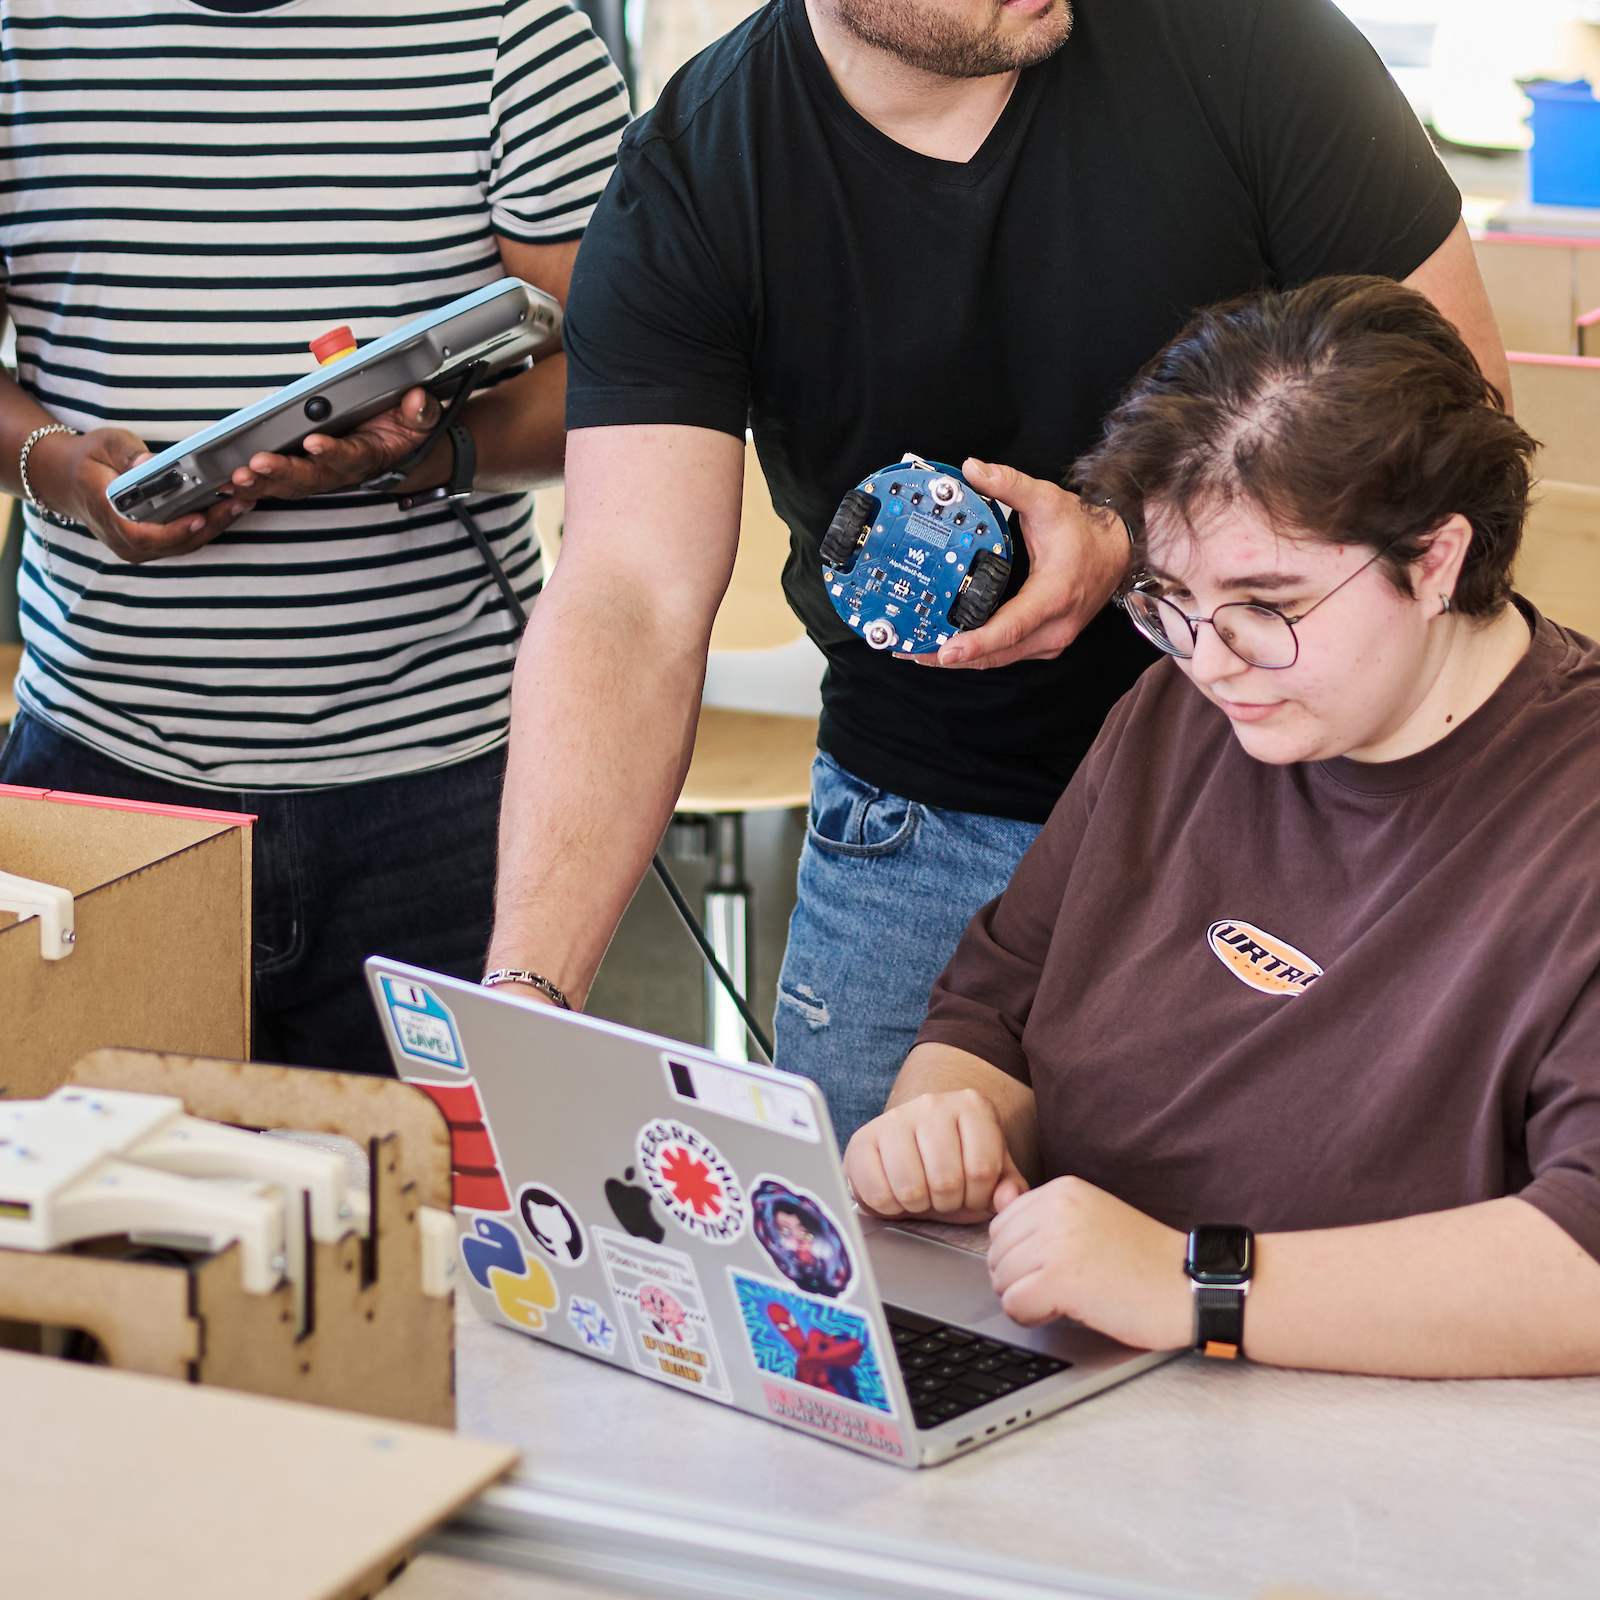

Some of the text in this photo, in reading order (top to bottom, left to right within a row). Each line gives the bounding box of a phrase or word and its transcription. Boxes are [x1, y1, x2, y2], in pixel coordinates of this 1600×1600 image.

[640, 1125, 743, 1239] RED HOT CHILI PEPPERS
[772, 1399, 902, 1455] WOMEN'S WRONGS
[802, 1399, 868, 1429] SUPPORT
